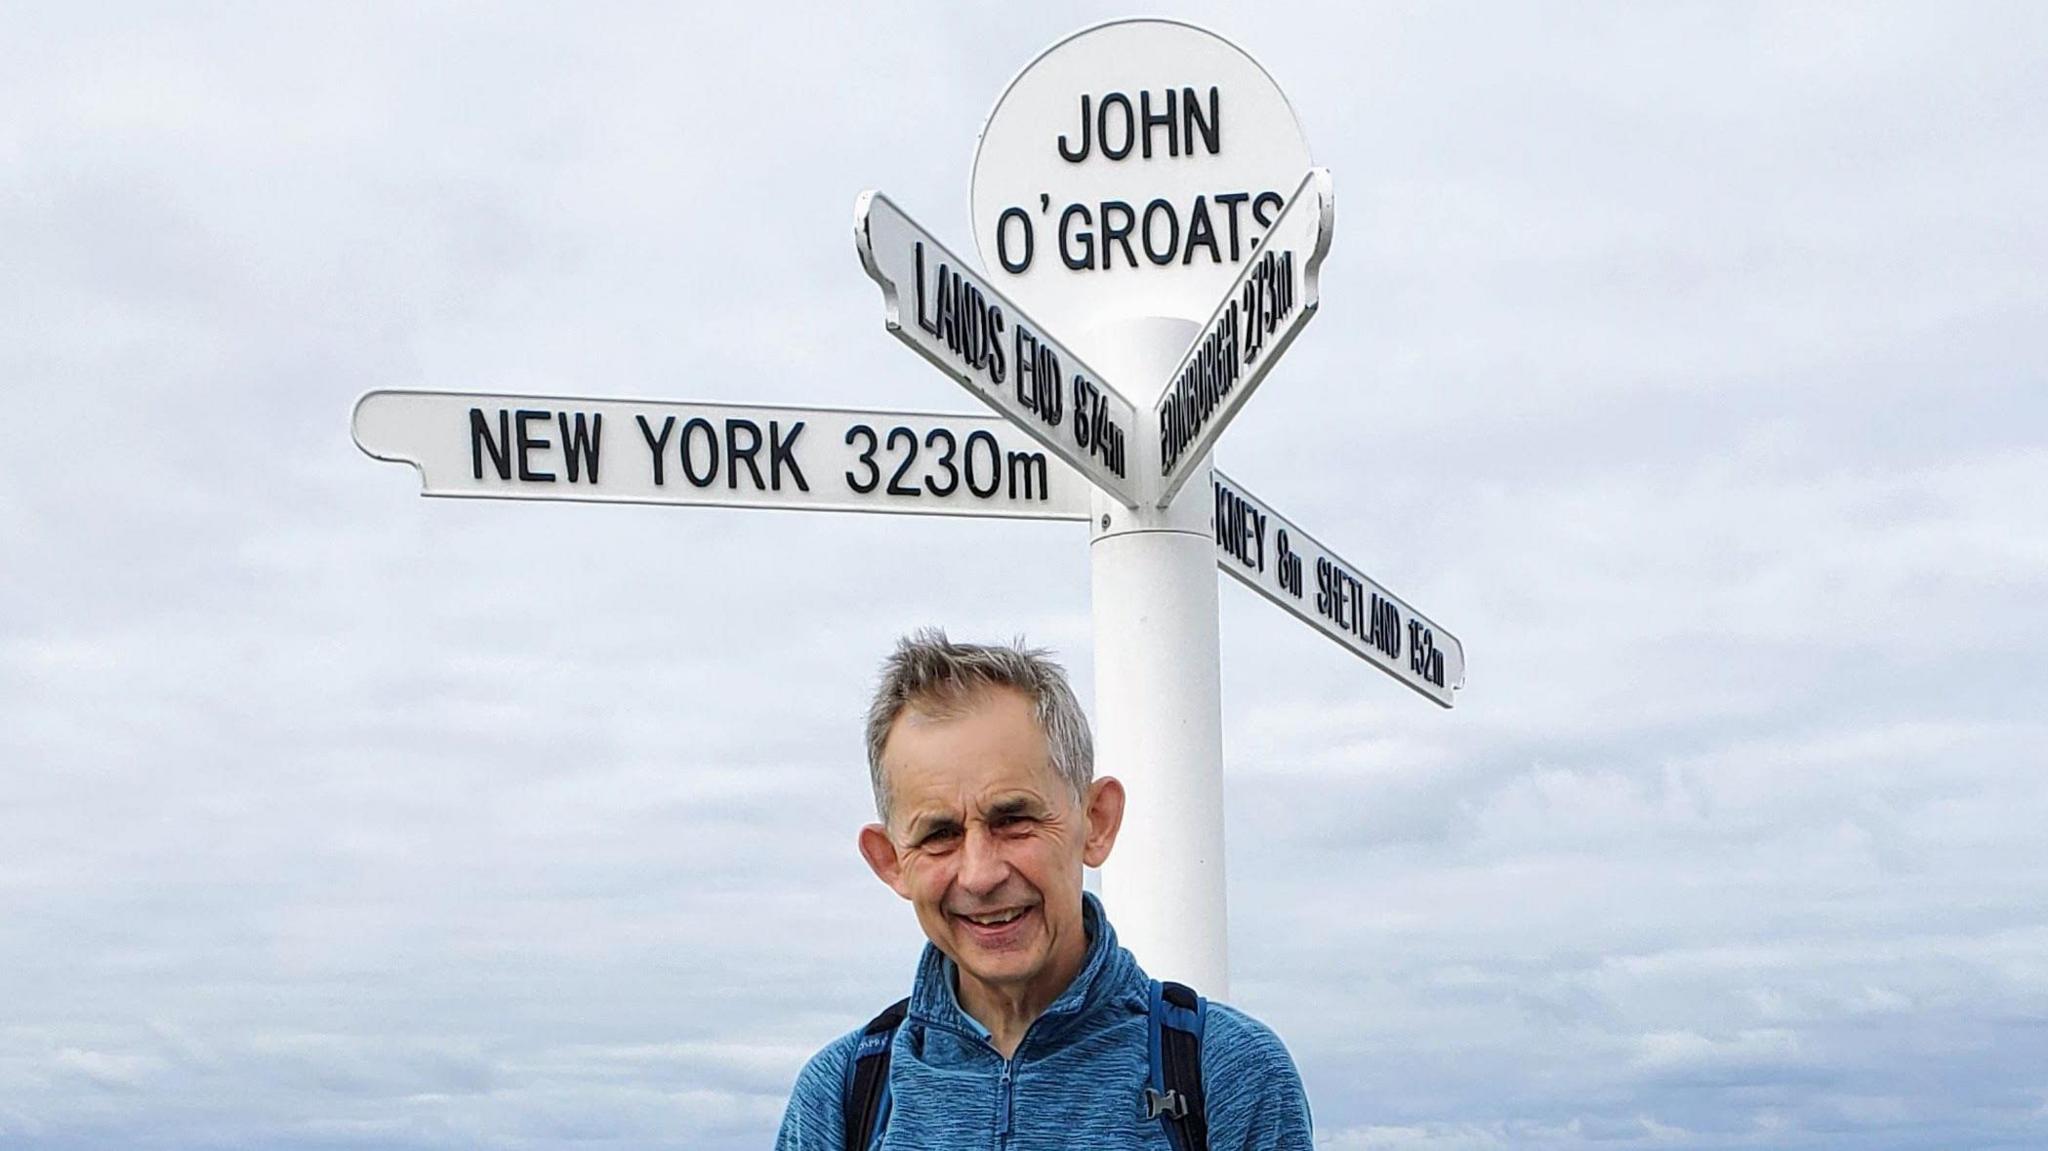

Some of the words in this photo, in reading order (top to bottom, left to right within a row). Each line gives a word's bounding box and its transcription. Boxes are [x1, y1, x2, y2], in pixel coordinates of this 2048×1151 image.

[1057, 86, 1221, 163] JOHN
[996, 191, 1285, 274] O'GROATS
[914, 241, 1006, 385] LANDS
[1016, 324, 1063, 428] END
[1073, 375, 1126, 480] 874m
[1160, 299, 1239, 477] EDINBURGH
[1242, 250, 1293, 364] 273m
[470, 408, 602, 484] NEW
[636, 414, 810, 492] YORK
[844, 424, 1049, 501] 3230m
[1211, 480, 1266, 573] KNEY
[1276, 528, 1302, 599] 8m
[1316, 556, 1401, 660] SHETLAND
[1408, 617, 1444, 688] 152m
